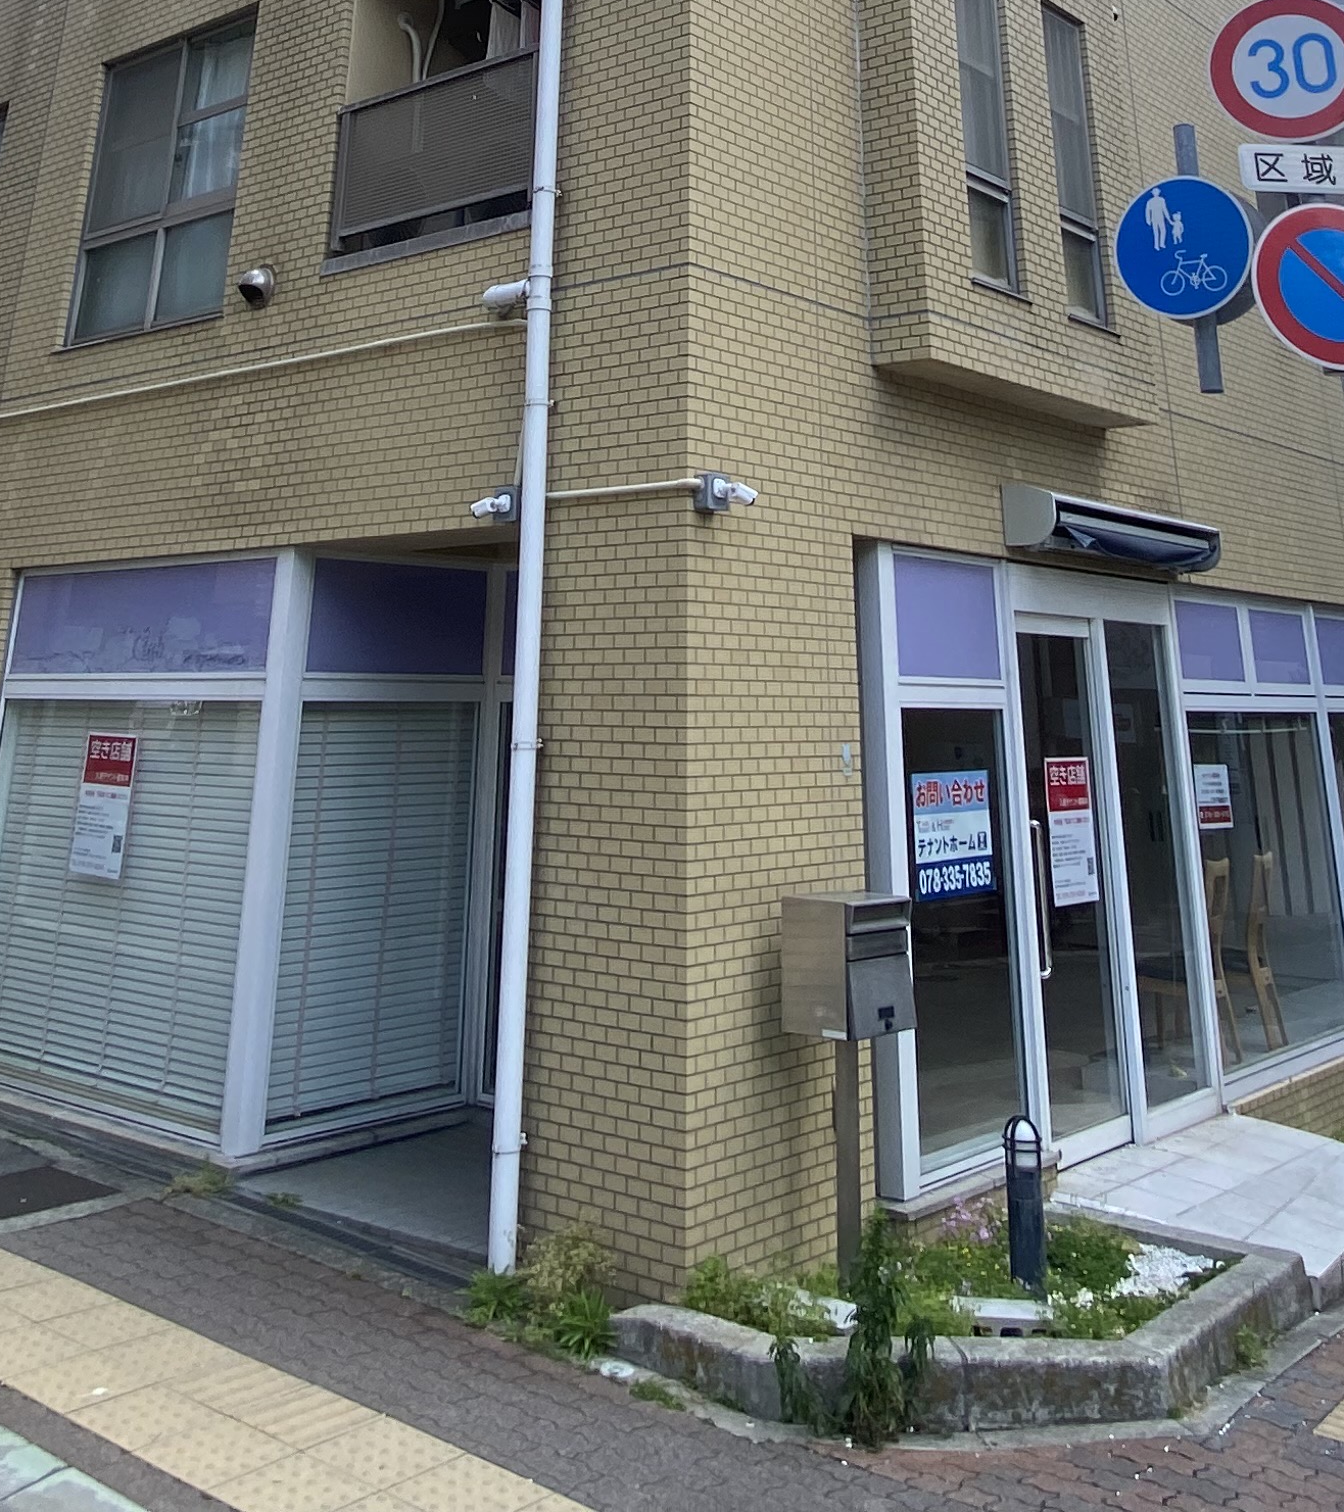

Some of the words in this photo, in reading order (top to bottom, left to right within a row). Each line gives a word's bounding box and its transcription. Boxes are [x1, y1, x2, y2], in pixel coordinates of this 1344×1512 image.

[1248, 32, 1337, 99] 30
[89, 739, 133, 762] 空き店舗
[1048, 764, 1086, 786] 空き店舗
[916, 779, 986, 808] お問い合わせ
[917, 833, 977, 858] テナントホーム
[918, 861, 992, 895] 078-335-7835
